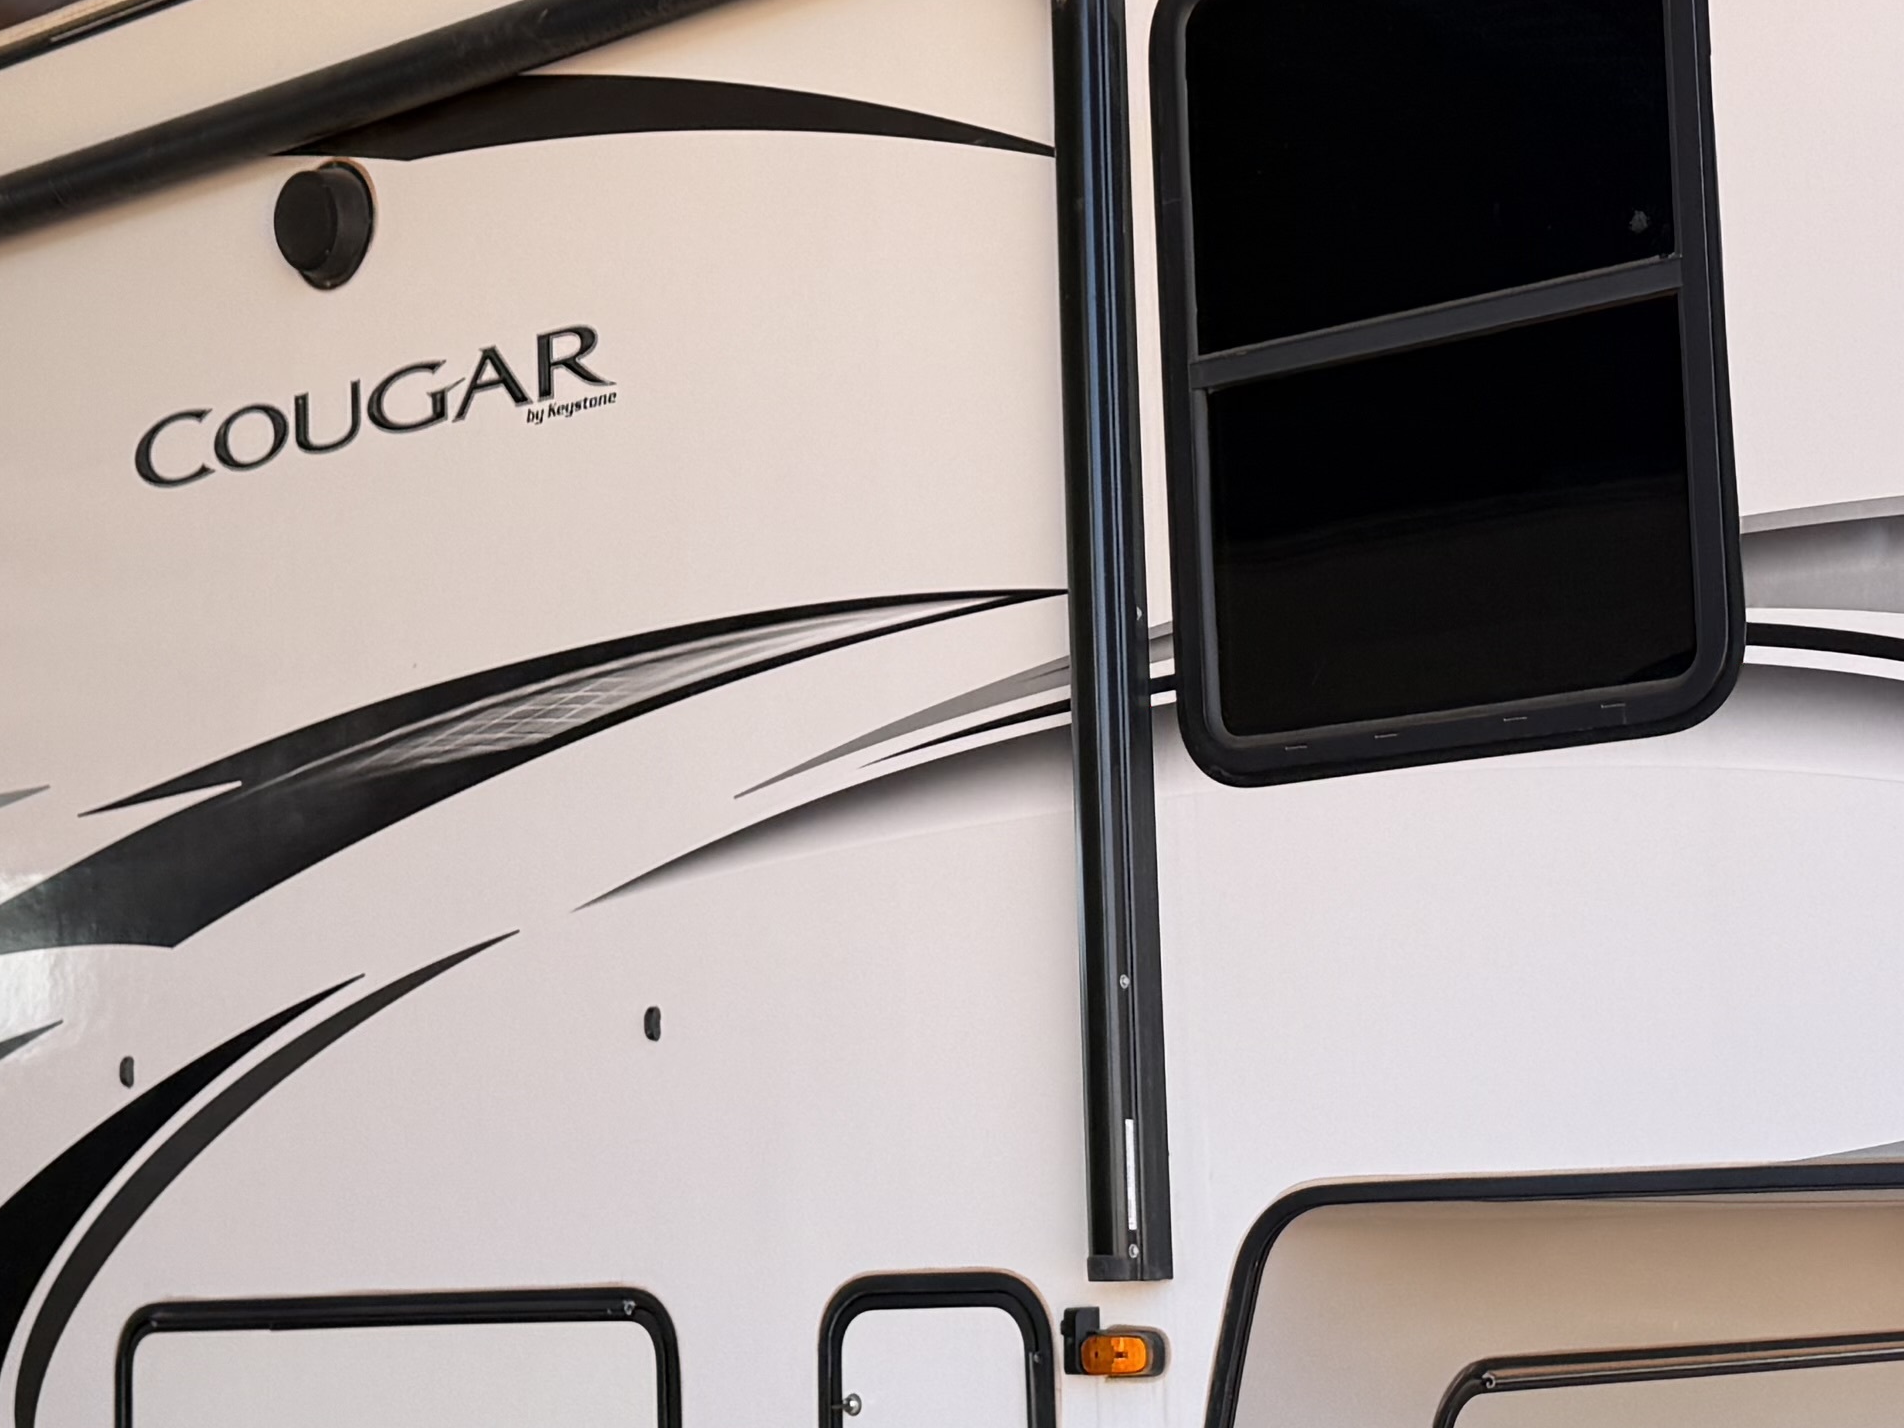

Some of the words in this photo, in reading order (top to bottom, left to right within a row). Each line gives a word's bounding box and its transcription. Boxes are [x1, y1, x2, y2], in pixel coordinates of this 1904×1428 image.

[134, 324, 618, 489] COUGAR
[526, 408, 545, 426] by
[547, 391, 617, 419] Keystone
